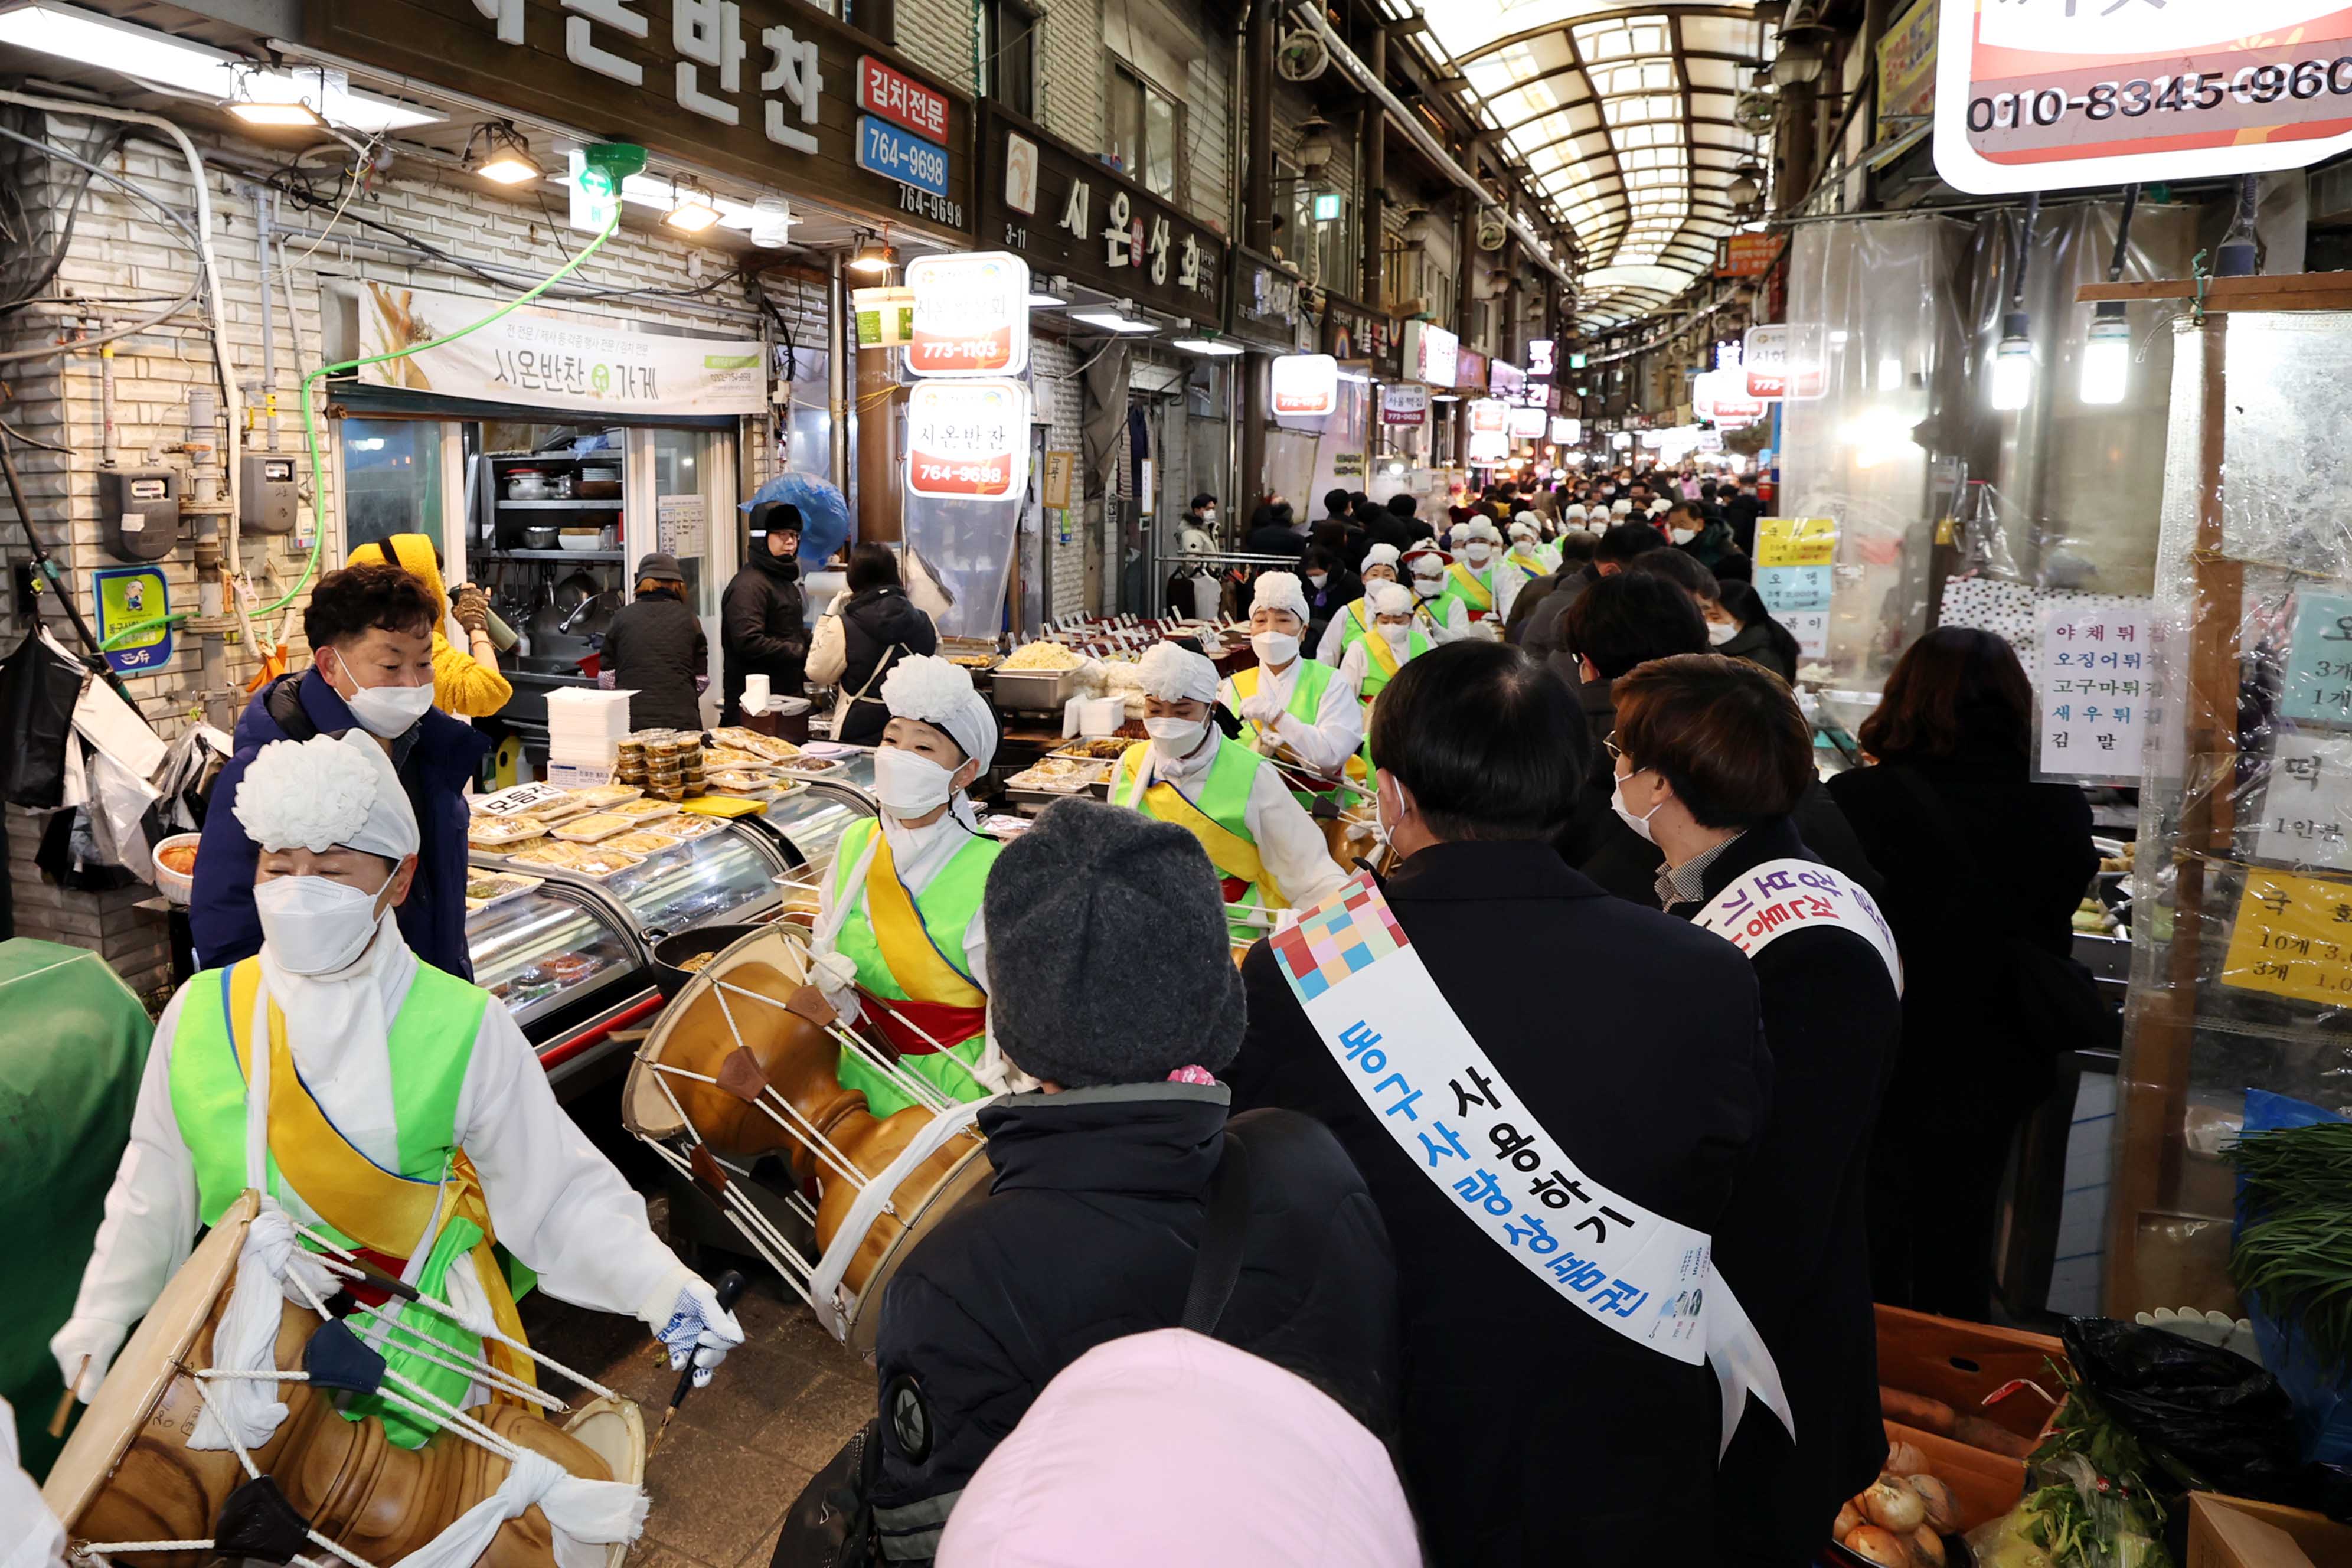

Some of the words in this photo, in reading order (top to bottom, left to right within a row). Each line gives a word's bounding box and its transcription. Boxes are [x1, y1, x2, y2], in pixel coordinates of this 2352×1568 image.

[870, 66, 946, 135] 김치전문
[869, 127, 945, 188] 764-9698
[899, 183, 962, 227] 764-9698
[1005, 223, 1027, 249] 3-11
[922, 341, 998, 359] 773-1103
[494, 349, 586, 398] 시온반찬
[616, 364, 661, 401] 가게
[920, 464, 1001, 483] 764-9698
[486, 784, 563, 814] 모듬전
[2260, 933, 2311, 956] 10개
[2253, 961, 2289, 982] 3개
[1338, 1019, 1650, 1318] 동구사랑상품권
[1446, 1064, 1636, 1244] 사용하기
